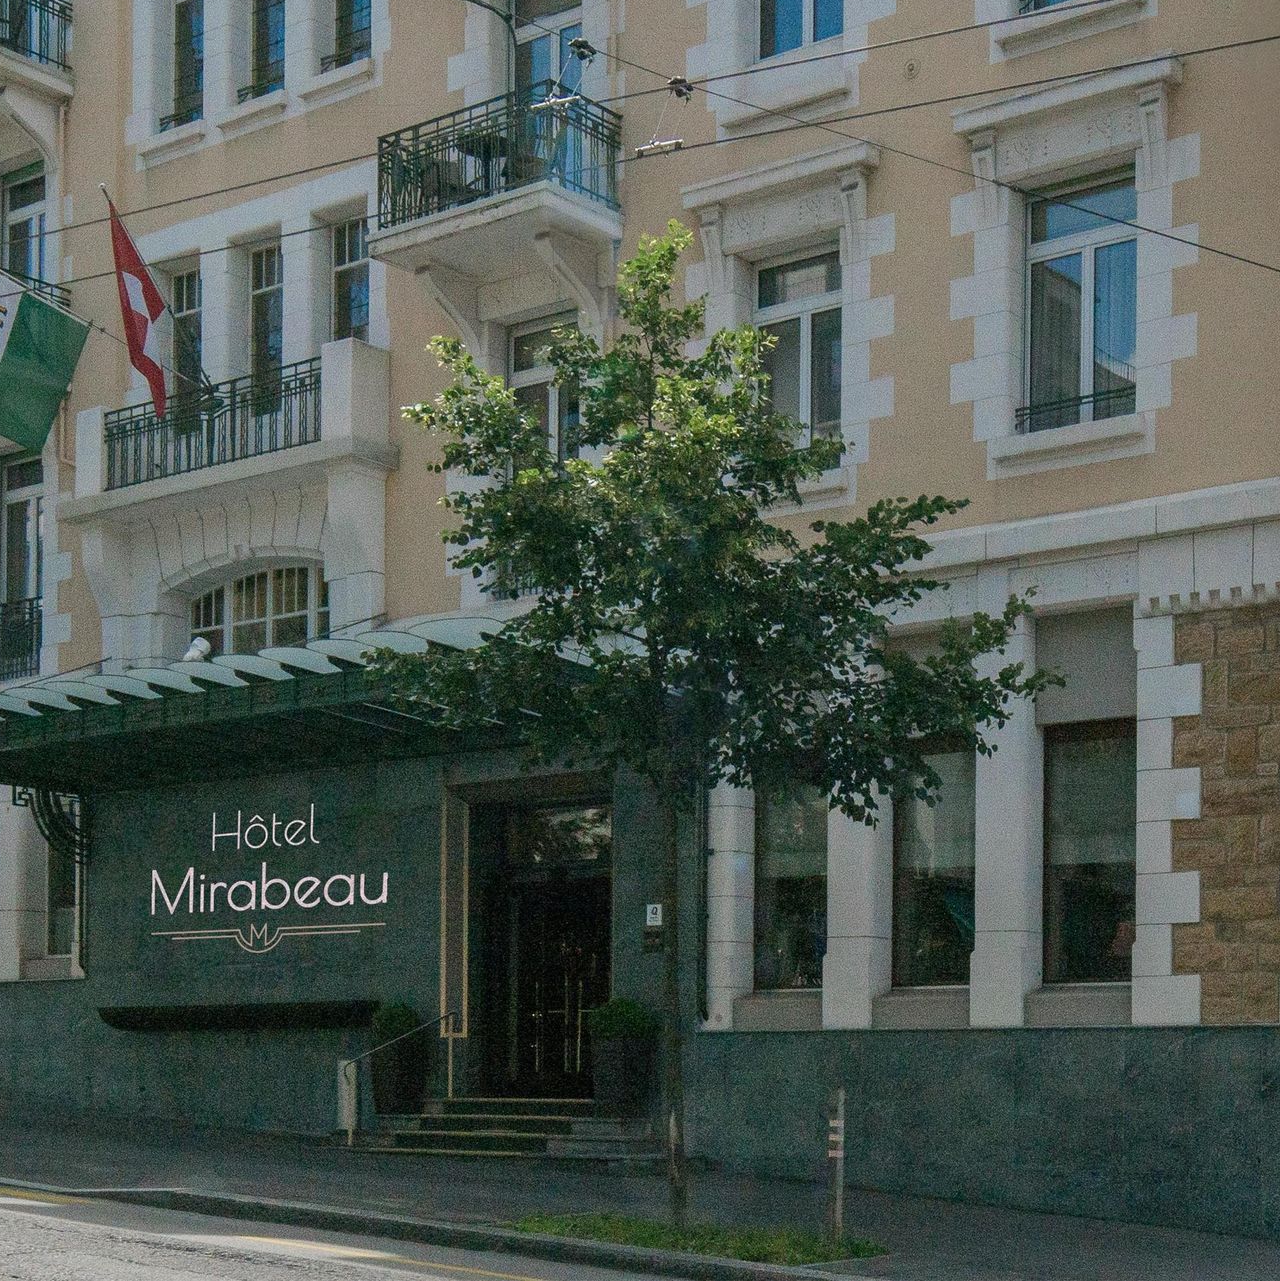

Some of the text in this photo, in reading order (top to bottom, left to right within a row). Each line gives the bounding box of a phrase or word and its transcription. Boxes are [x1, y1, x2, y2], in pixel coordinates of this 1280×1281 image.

[212, 803, 320, 851] Hôtel
[151, 862, 389, 915] Mirabeau
[250, 923, 268, 947] M
